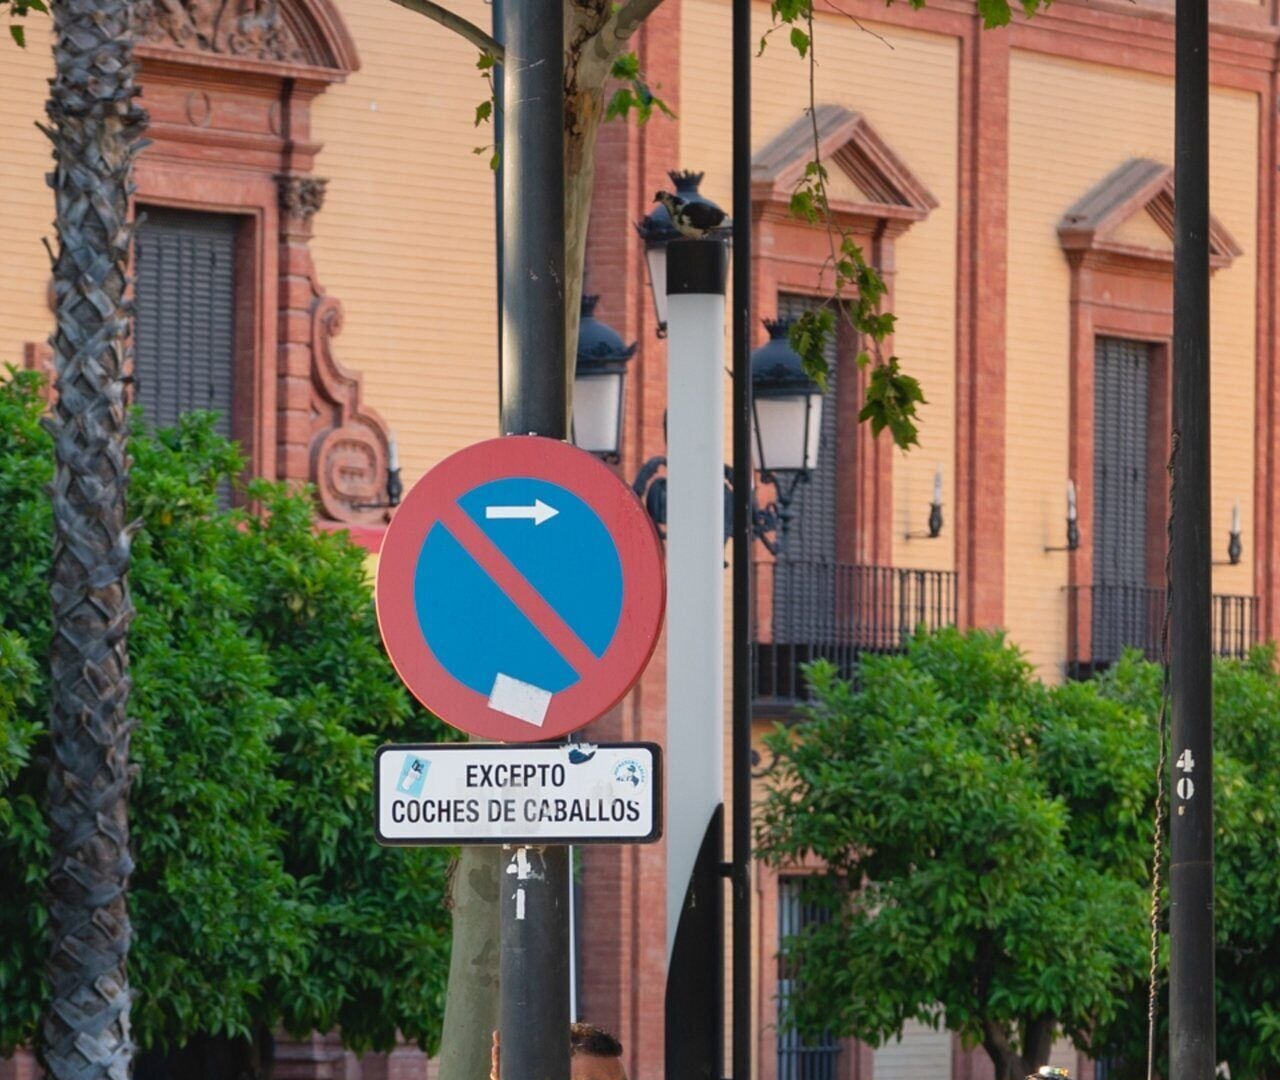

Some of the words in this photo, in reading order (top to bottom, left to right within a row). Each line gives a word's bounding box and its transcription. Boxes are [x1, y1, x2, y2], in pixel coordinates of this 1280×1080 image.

[466, 764, 565, 788] EXCEPTO
[391, 799, 480, 823] COCHES
[487, 799, 516, 823] DE
[523, 798, 640, 822] CABALLOS
